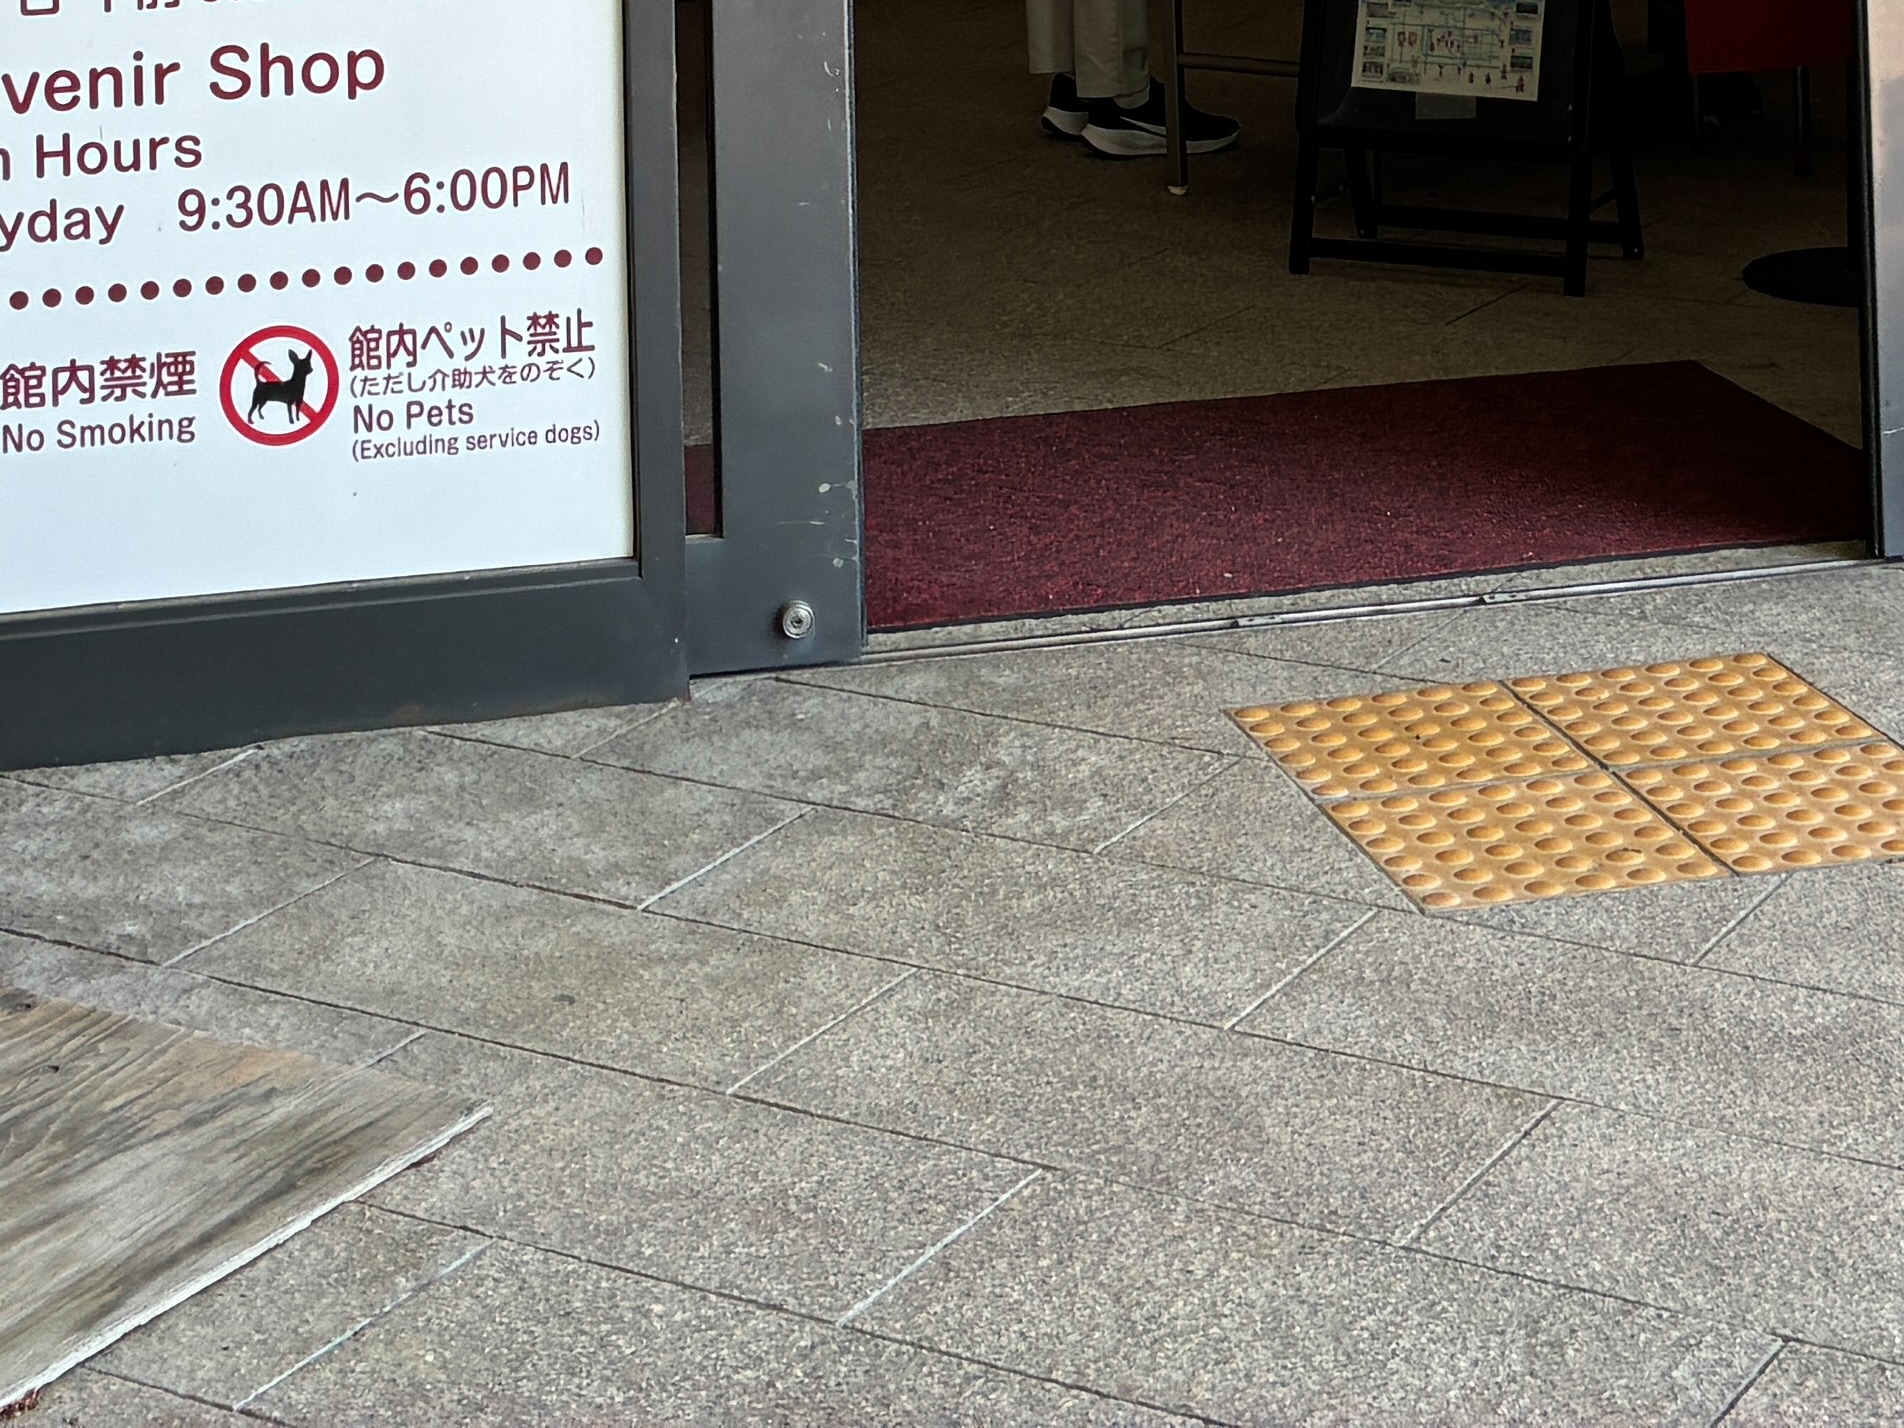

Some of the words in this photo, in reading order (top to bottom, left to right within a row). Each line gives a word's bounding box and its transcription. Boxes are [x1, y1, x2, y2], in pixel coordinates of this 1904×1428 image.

[209, 42, 386, 103] Shop
[36, 129, 202, 177] Hours
[349, 309, 595, 371] 館内ペット禁止
[0, 351, 197, 412] 館内禁煙
[350, 356, 596, 400] (ただし介助犬をのぞく)
[2, 422, 46, 455] No
[56, 409, 197, 455] Smoking
[353, 402, 395, 433] No
[406, 399, 475, 430] Pets
[352, 430, 459, 463] (Excluding
[465, 426, 538, 454] service
[544, 420, 601, 449] dogs)
